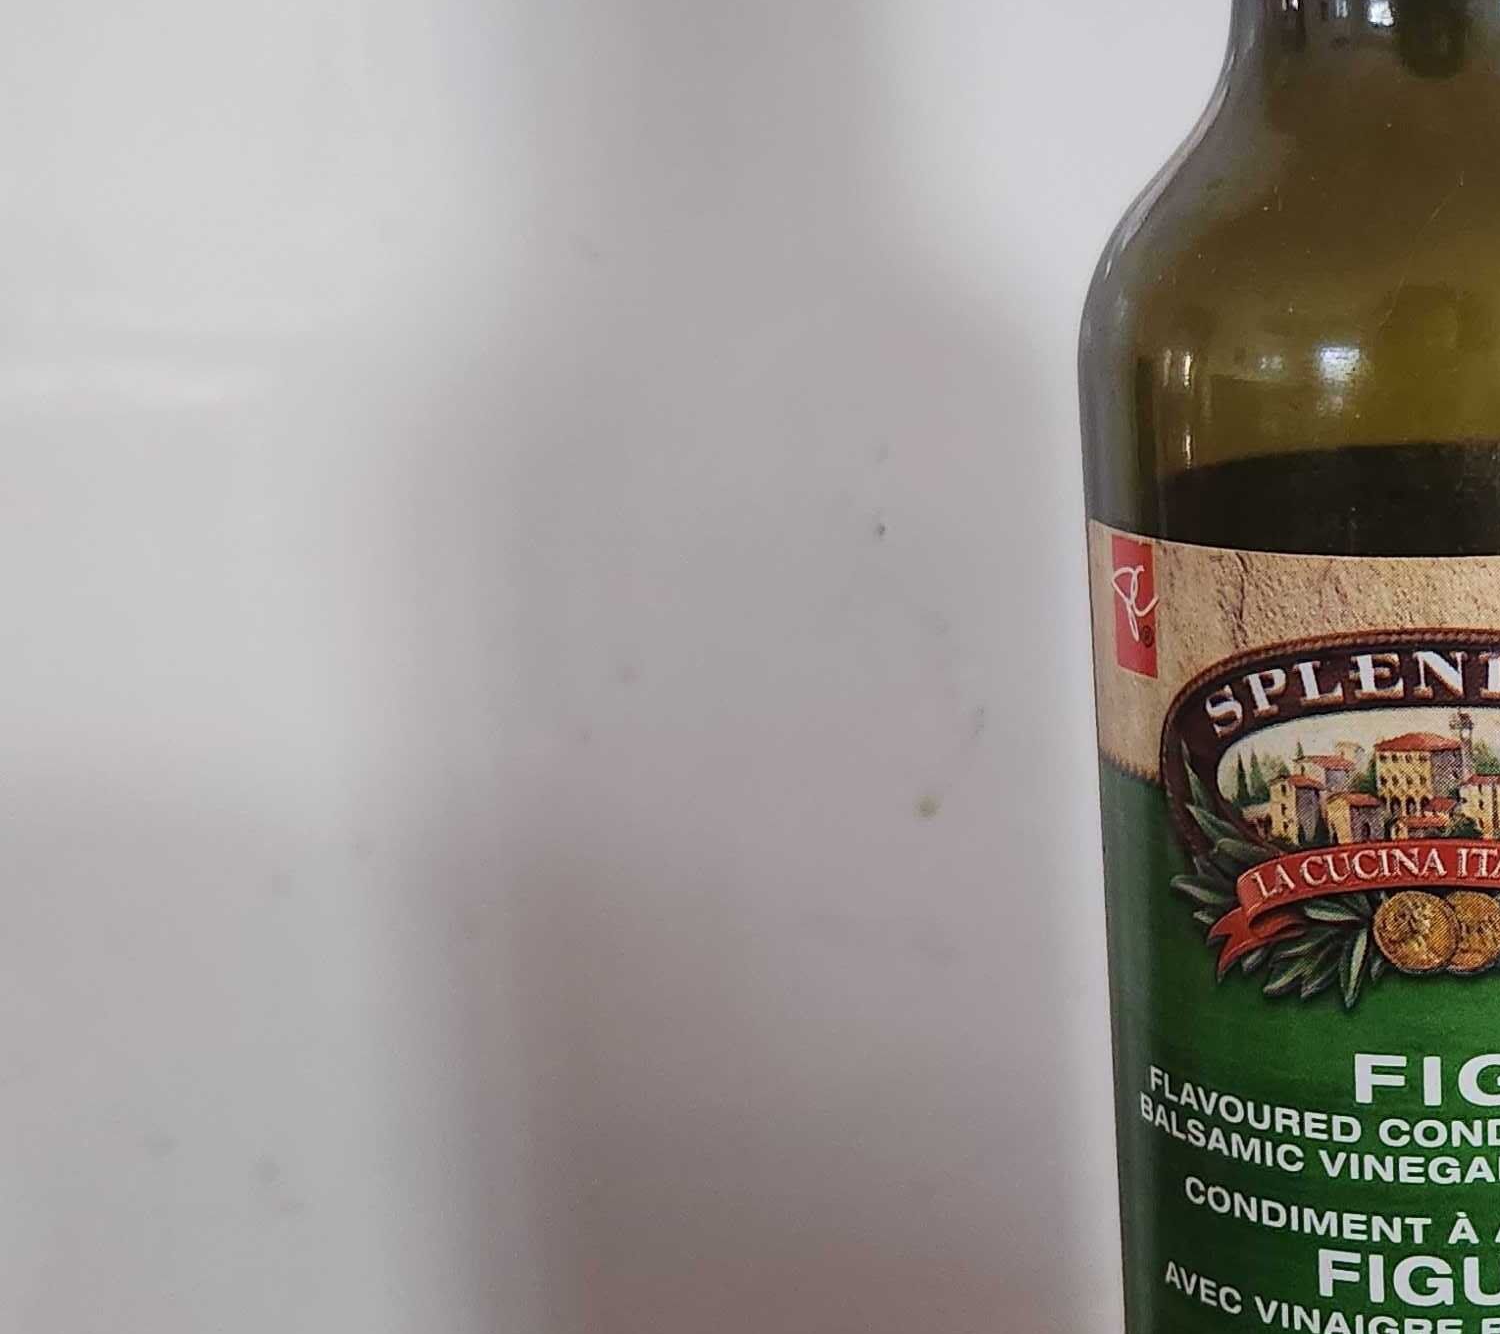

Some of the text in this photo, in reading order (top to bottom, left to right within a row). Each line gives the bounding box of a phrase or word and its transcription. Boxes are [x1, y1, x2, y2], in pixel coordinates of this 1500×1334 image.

[1251, 863, 1297, 900] LA
[1301, 846, 1448, 886] CUCINA
[1139, 1090, 1305, 1172] BALSAMIC
[1150, 1064, 1362, 1144] FLAVOURED
[1184, 1175, 1432, 1244] CONDIMENT
[1448, 1211, 1479, 1244] À
[1164, 1261, 1242, 1315] AVEC
